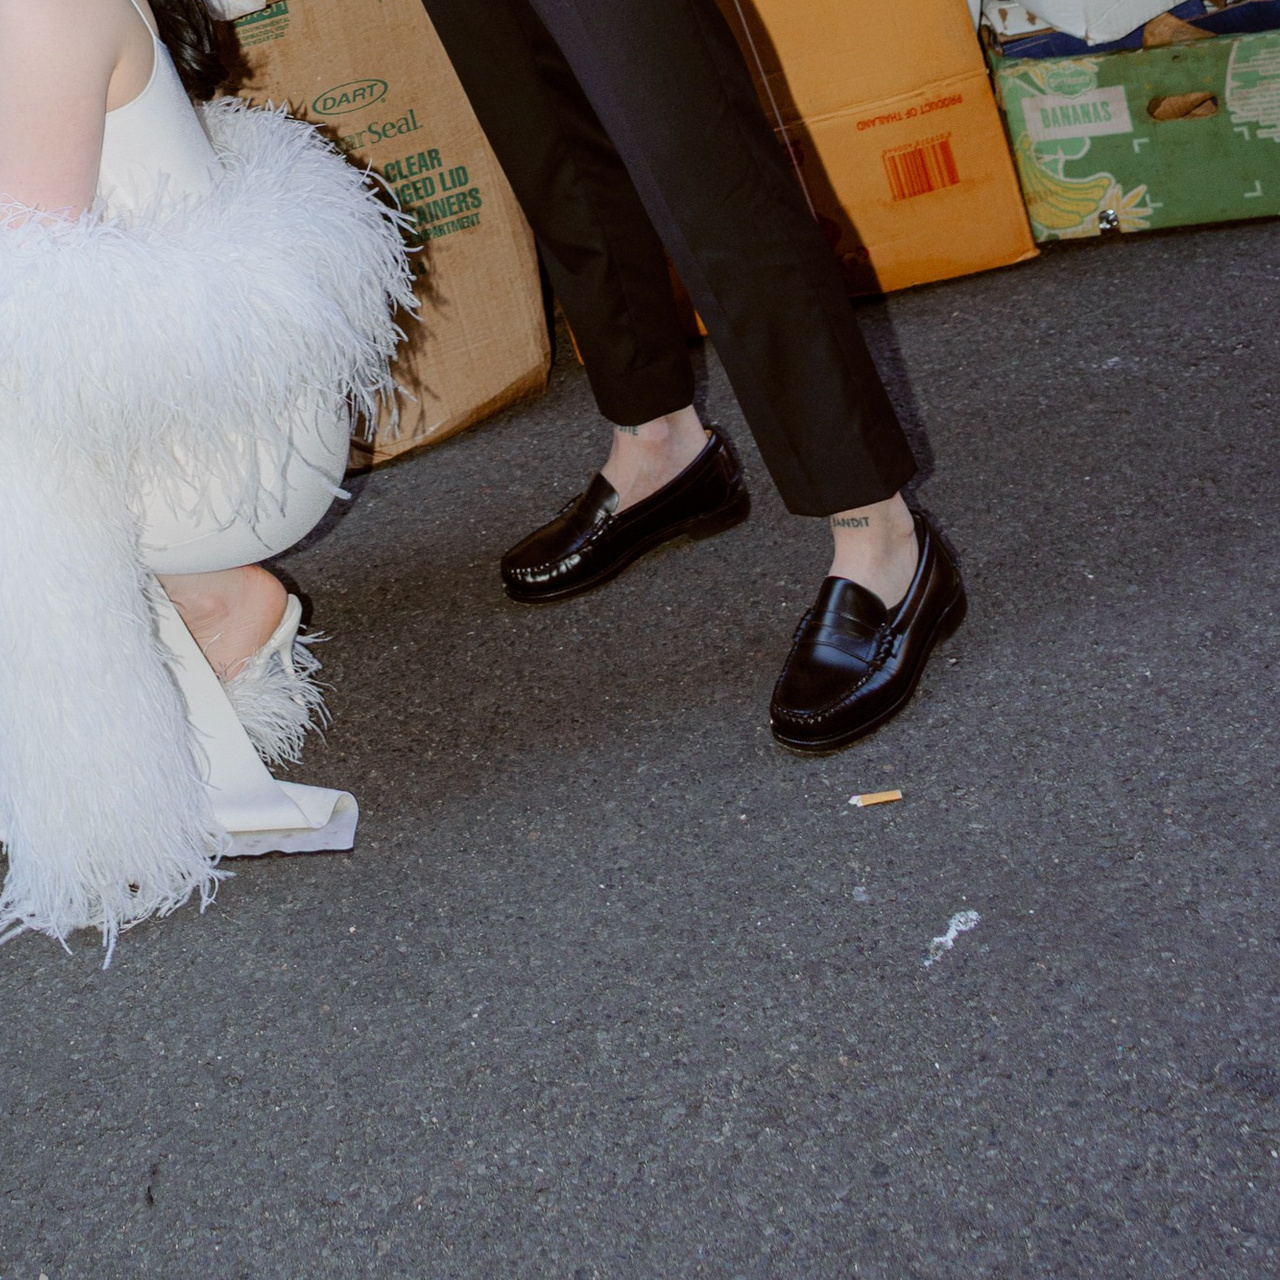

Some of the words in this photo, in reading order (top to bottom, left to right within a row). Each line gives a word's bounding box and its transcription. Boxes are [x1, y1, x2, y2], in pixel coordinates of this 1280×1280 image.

[321, 82, 380, 113] DART
[920, 92, 964, 120] PRODUCT
[855, 109, 900, 133] THAILAND
[901, 104, 919, 120] OF
[1039, 99, 1113, 131] BANANAS
[383, 147, 443, 185] CLEAR
[437, 164, 470, 191] LID
